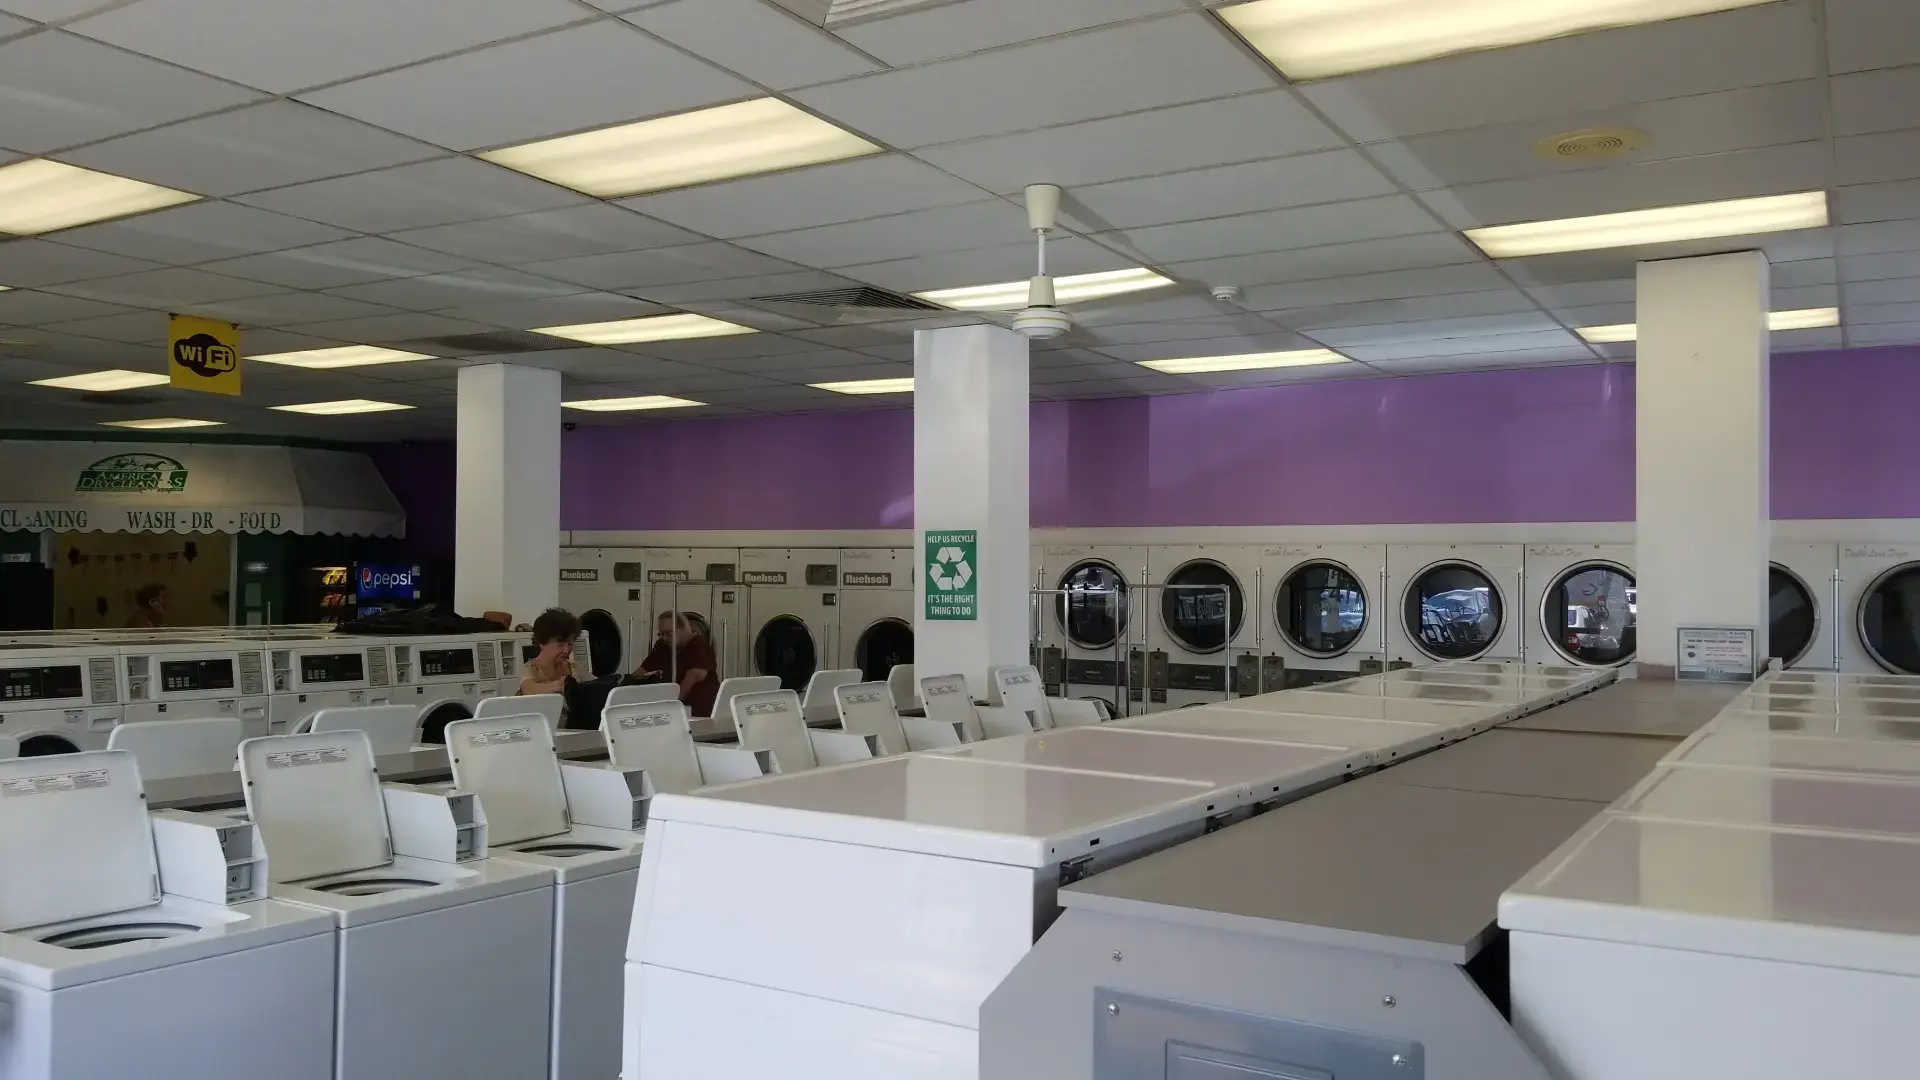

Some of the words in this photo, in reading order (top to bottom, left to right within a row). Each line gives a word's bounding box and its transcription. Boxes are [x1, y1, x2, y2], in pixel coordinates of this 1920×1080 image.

[927, 535, 942, 543] HELP
[943, 535, 950, 543] US
[951, 535, 975, 543] RECYCLE
[374, 570, 412, 588] pepsi
[561, 570, 596, 580] Huebsch
[649, 571, 687, 581] Huebsch
[744, 573, 785, 583] Huebsch
[845, 574, 889, 584] Huebsch
[927, 594, 940, 603] IT'S
[941, 594, 953, 603] THE
[954, 594, 974, 603] RIGHT
[931, 606, 951, 615] THING
[951, 606, 960, 615] TO
[961, 606, 971, 615] DO
